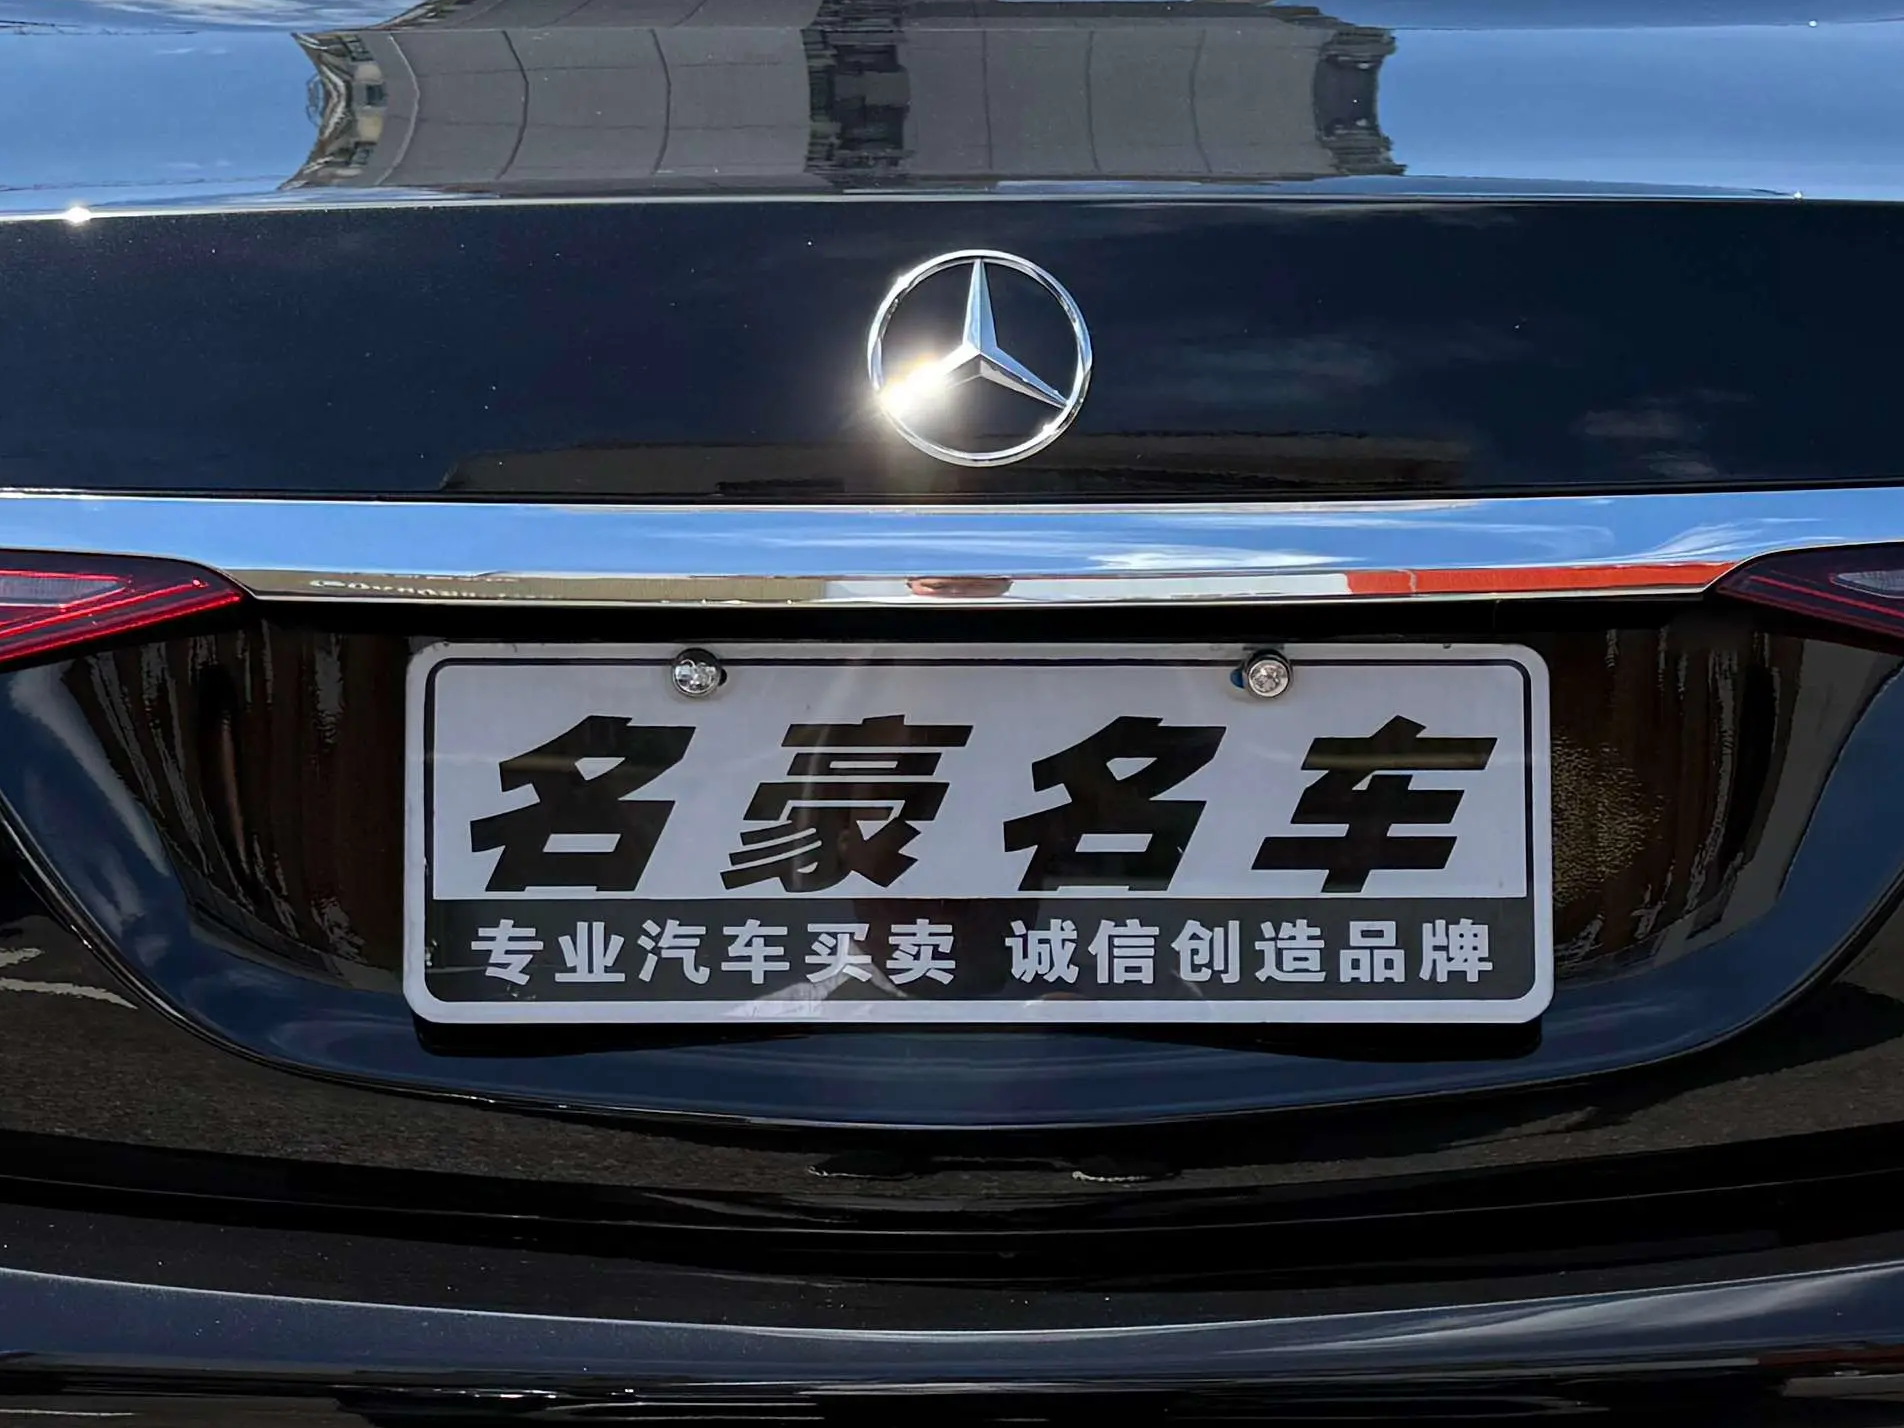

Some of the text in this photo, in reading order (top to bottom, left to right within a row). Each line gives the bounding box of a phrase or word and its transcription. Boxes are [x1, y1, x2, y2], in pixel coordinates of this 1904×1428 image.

[469, 714, 1497, 894] 名豪名车
[470, 918, 1494, 985] 专业汽车买卖 诚信创造品牌
